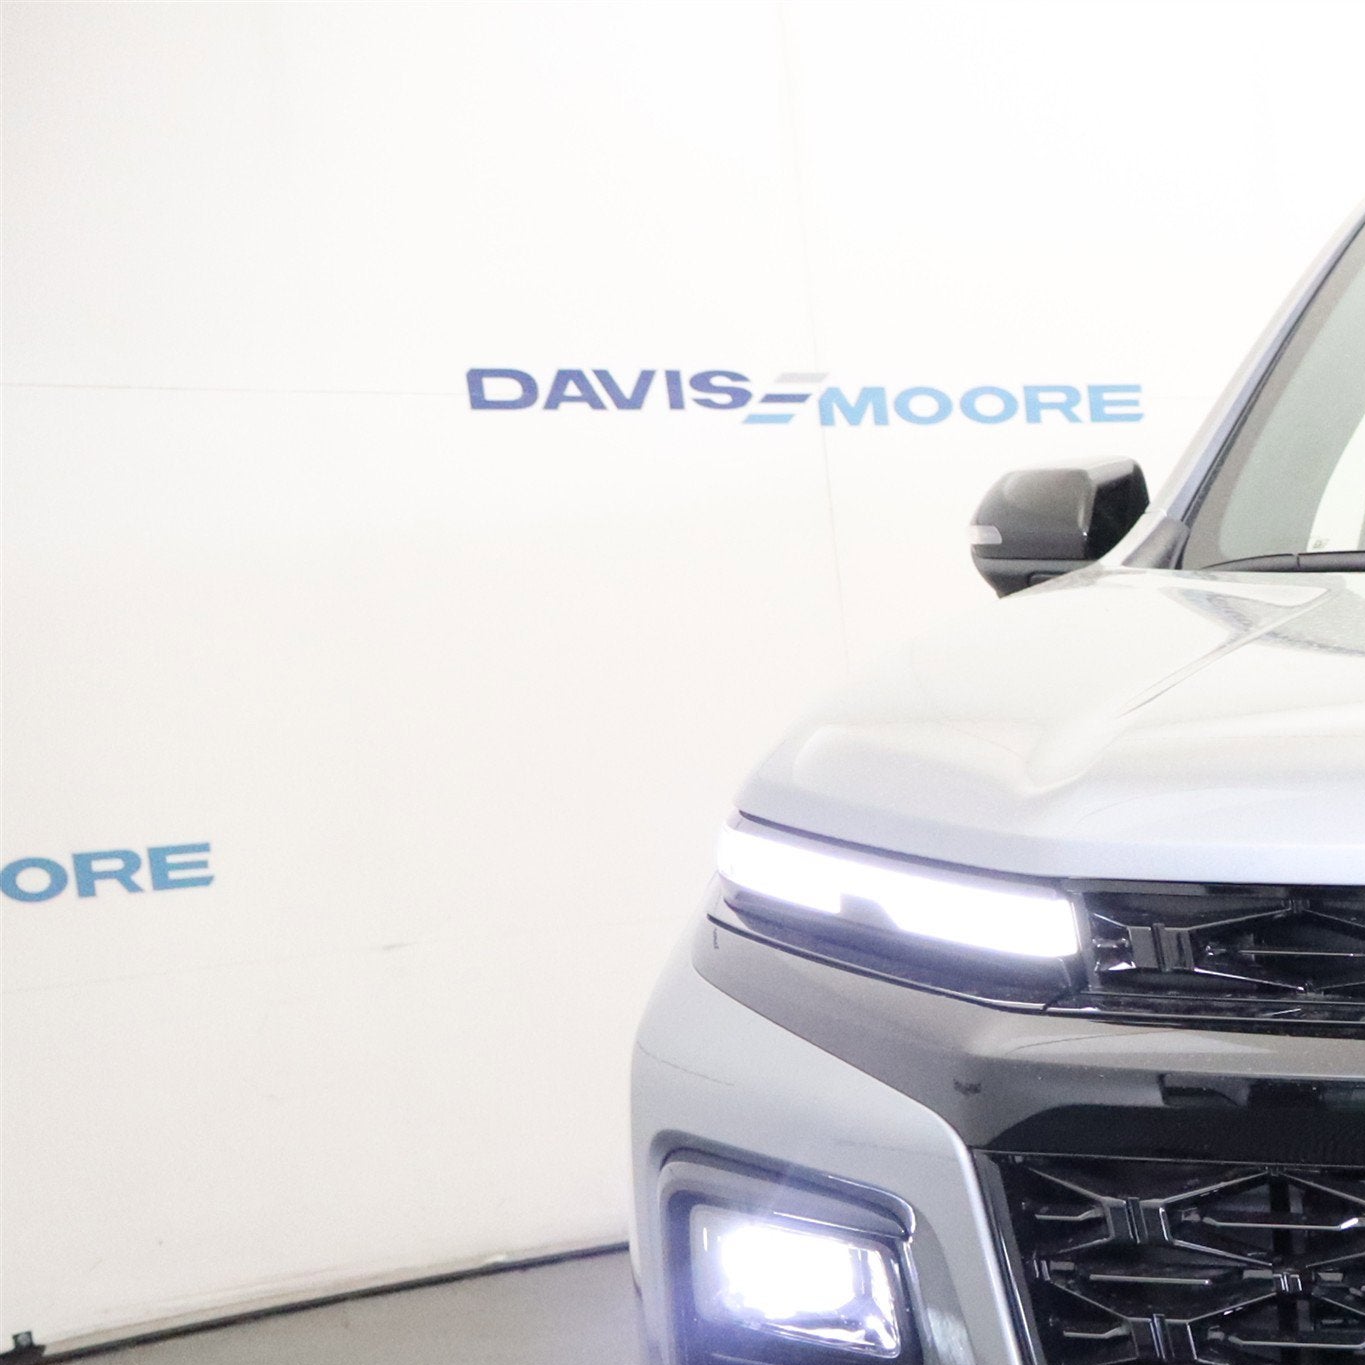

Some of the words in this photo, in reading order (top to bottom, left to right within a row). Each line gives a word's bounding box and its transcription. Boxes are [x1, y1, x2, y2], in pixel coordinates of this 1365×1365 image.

[466, 368, 753, 410] DAVIS
[818, 384, 1144, 426] MOORE
[0, 842, 215, 902] ORE
